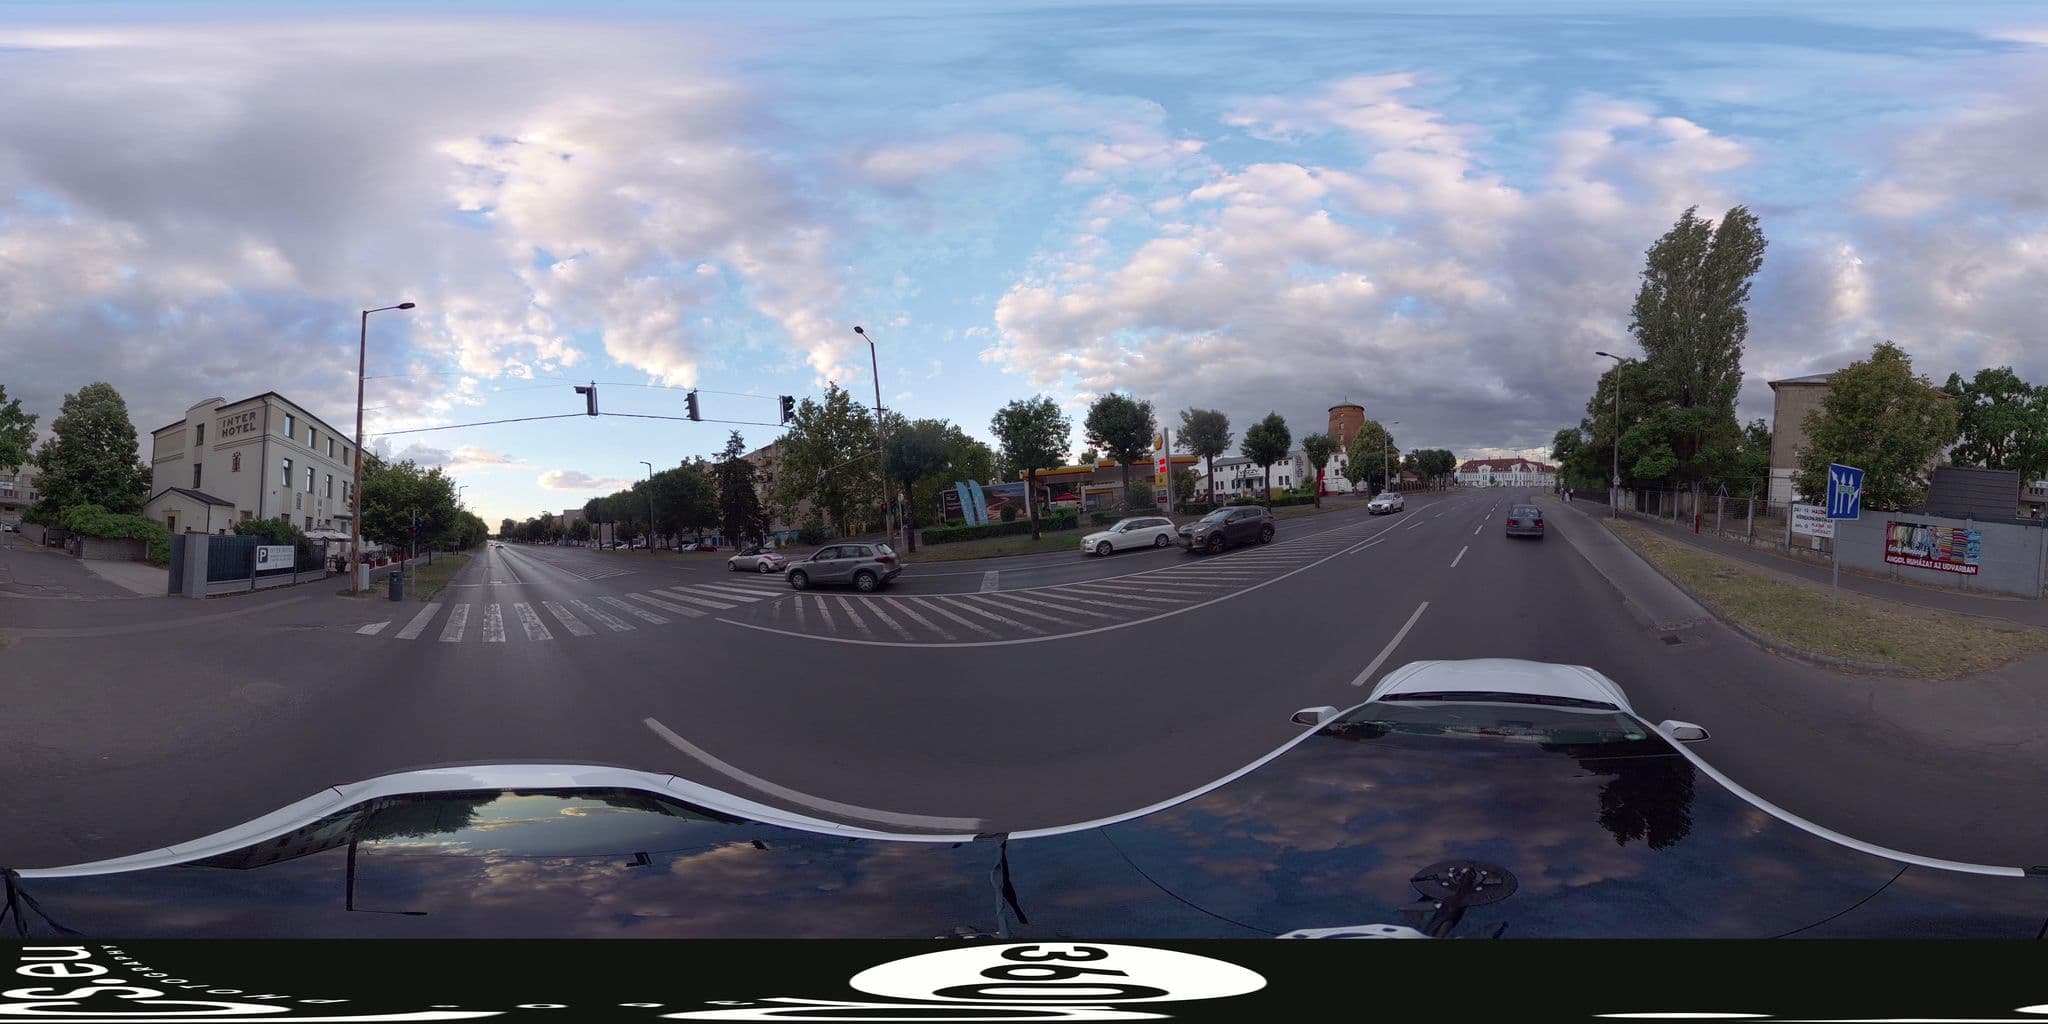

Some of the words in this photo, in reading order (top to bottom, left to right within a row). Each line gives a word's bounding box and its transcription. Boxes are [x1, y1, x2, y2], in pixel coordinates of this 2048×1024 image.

[222, 412, 256, 427] INTER
[222, 422, 256, 437] HOTEL
[1886, 555, 1905, 564] ANGOL
[1933, 561, 1942, 569] AZ
